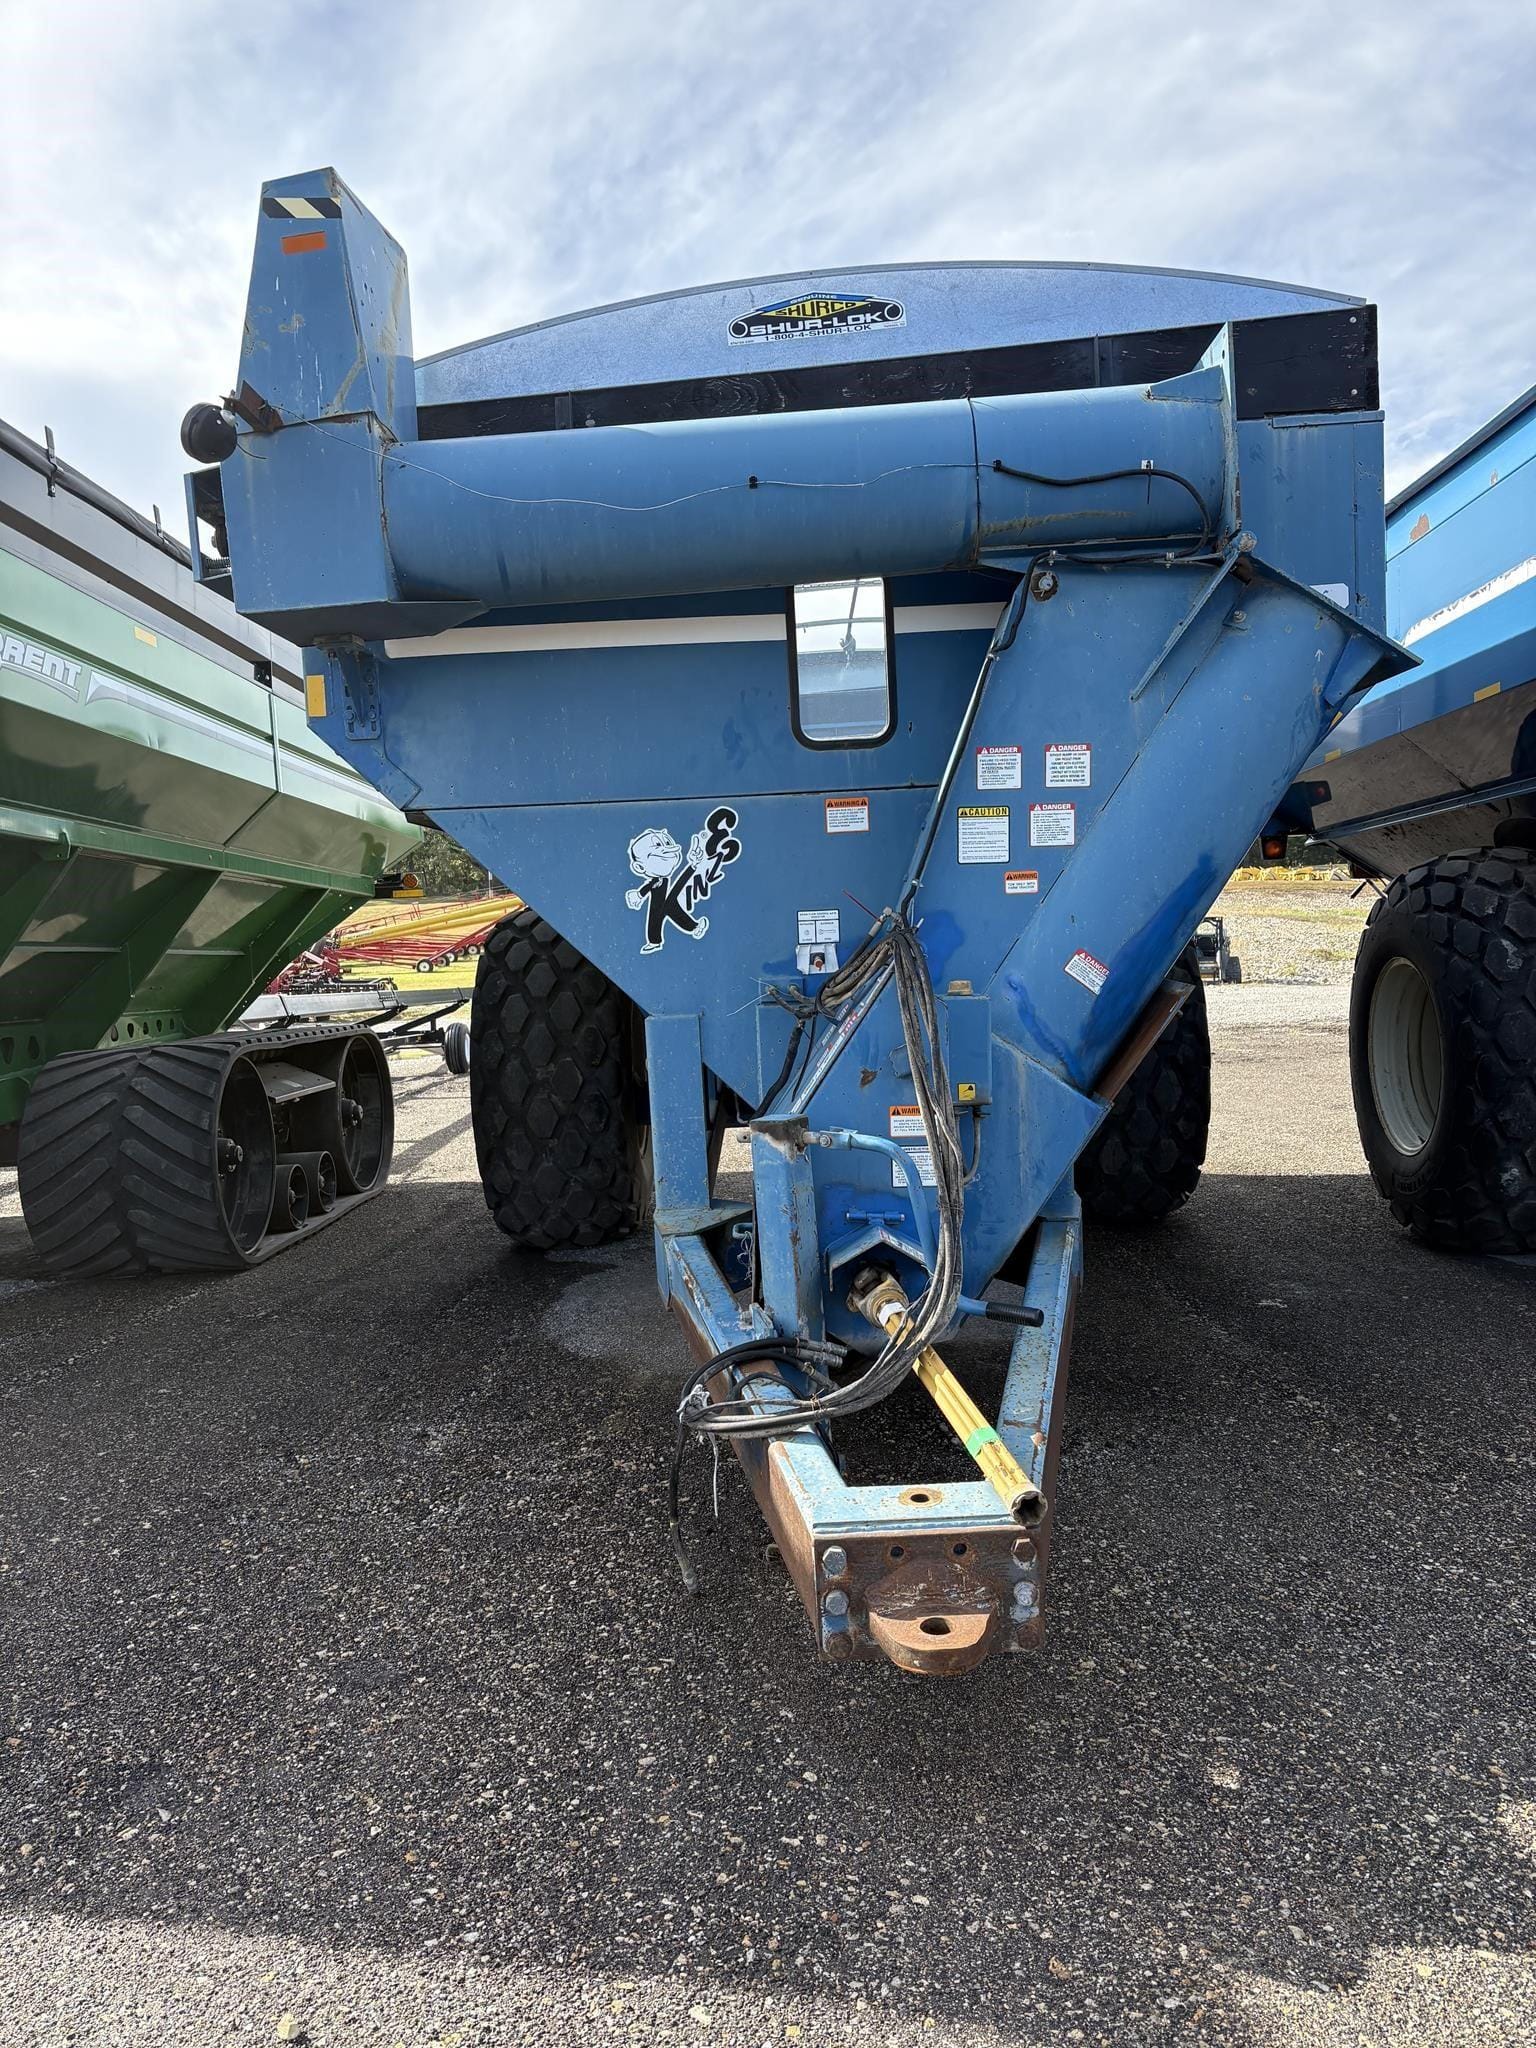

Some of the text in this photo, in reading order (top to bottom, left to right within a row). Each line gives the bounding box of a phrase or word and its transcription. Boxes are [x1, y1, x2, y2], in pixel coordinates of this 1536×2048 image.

[775, 300, 857, 318] SHURCO
[750, 311, 883, 336] SHUR-LOK
[765, 324, 872, 342] 1-800-4-SHUR-LOK
[0, 633, 82, 688] RENT
[1058, 744, 1087, 752] DANGER
[968, 807, 1008, 816] CAUTION
[1012, 872, 1038, 880] WARNING
